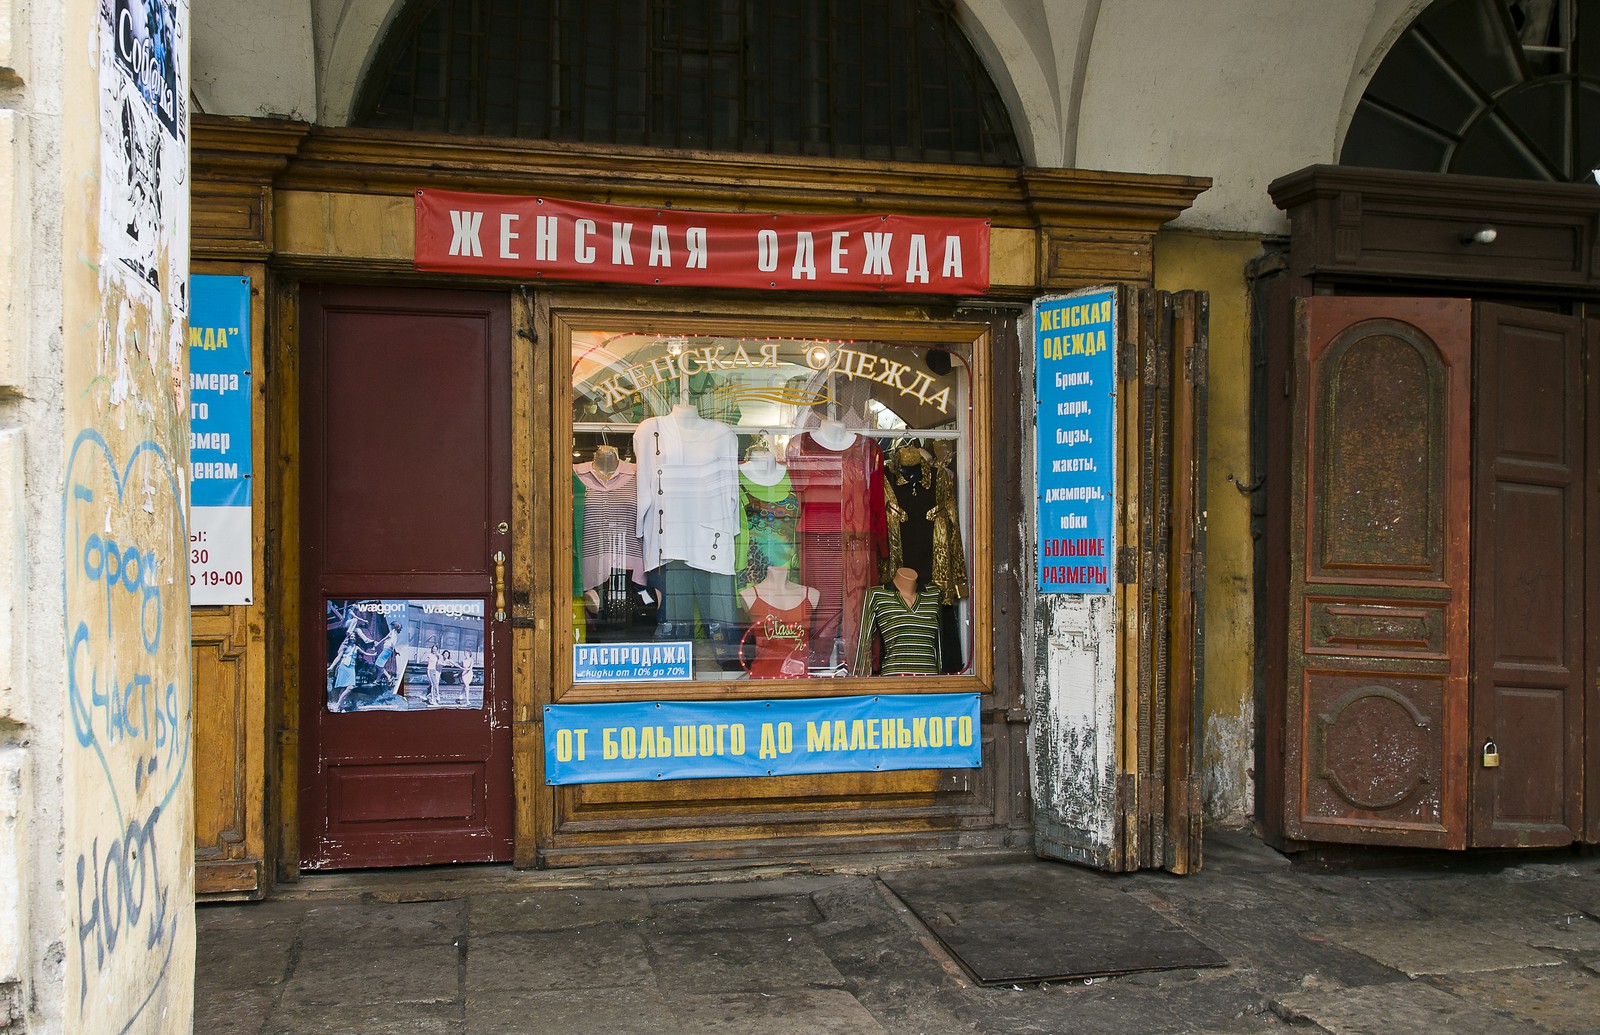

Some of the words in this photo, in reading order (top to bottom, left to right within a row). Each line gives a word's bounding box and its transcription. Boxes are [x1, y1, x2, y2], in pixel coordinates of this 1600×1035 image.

[448, 210, 707, 269] ЖЕНСКАЯ
[758, 230, 963, 283] ОДЕЖДА
[1040, 301, 1111, 332] ЖЕНСКАЯ
[1043, 330, 1106, 361] ОДЕЖДА
[592, 344, 780, 408] ЖЕНСКАЯ
[805, 345, 951, 414] ОДЕЖДА
[1055, 371, 1093, 390] Брюки,
[1057, 400, 1092, 417] капри,
[1056, 428, 1092, 447] блузы,
[1052, 457, 1097, 473] жакеты,
[1046, 486, 1105, 503] джемперы,
[1060, 513, 1087, 529] юбки
[1044, 538, 1105, 557] БОЛЬШИЕ
[202, 571, 243, 586] 19-00
[1043, 565, 1107, 585] РАЗМЕРЫ
[579, 646, 686, 666] РАСПРОДАЖА
[615, 669, 630, 677] от
[633, 668, 651, 677] 10%
[653, 669, 665, 678] до
[667, 667, 685, 676] 70%
[556, 729, 588, 762] ОТ
[602, 723, 745, 760] БОЛЬШОГО
[759, 721, 793, 759] ДО
[806, 715, 973, 753] МАЛЕНЬКОГО
